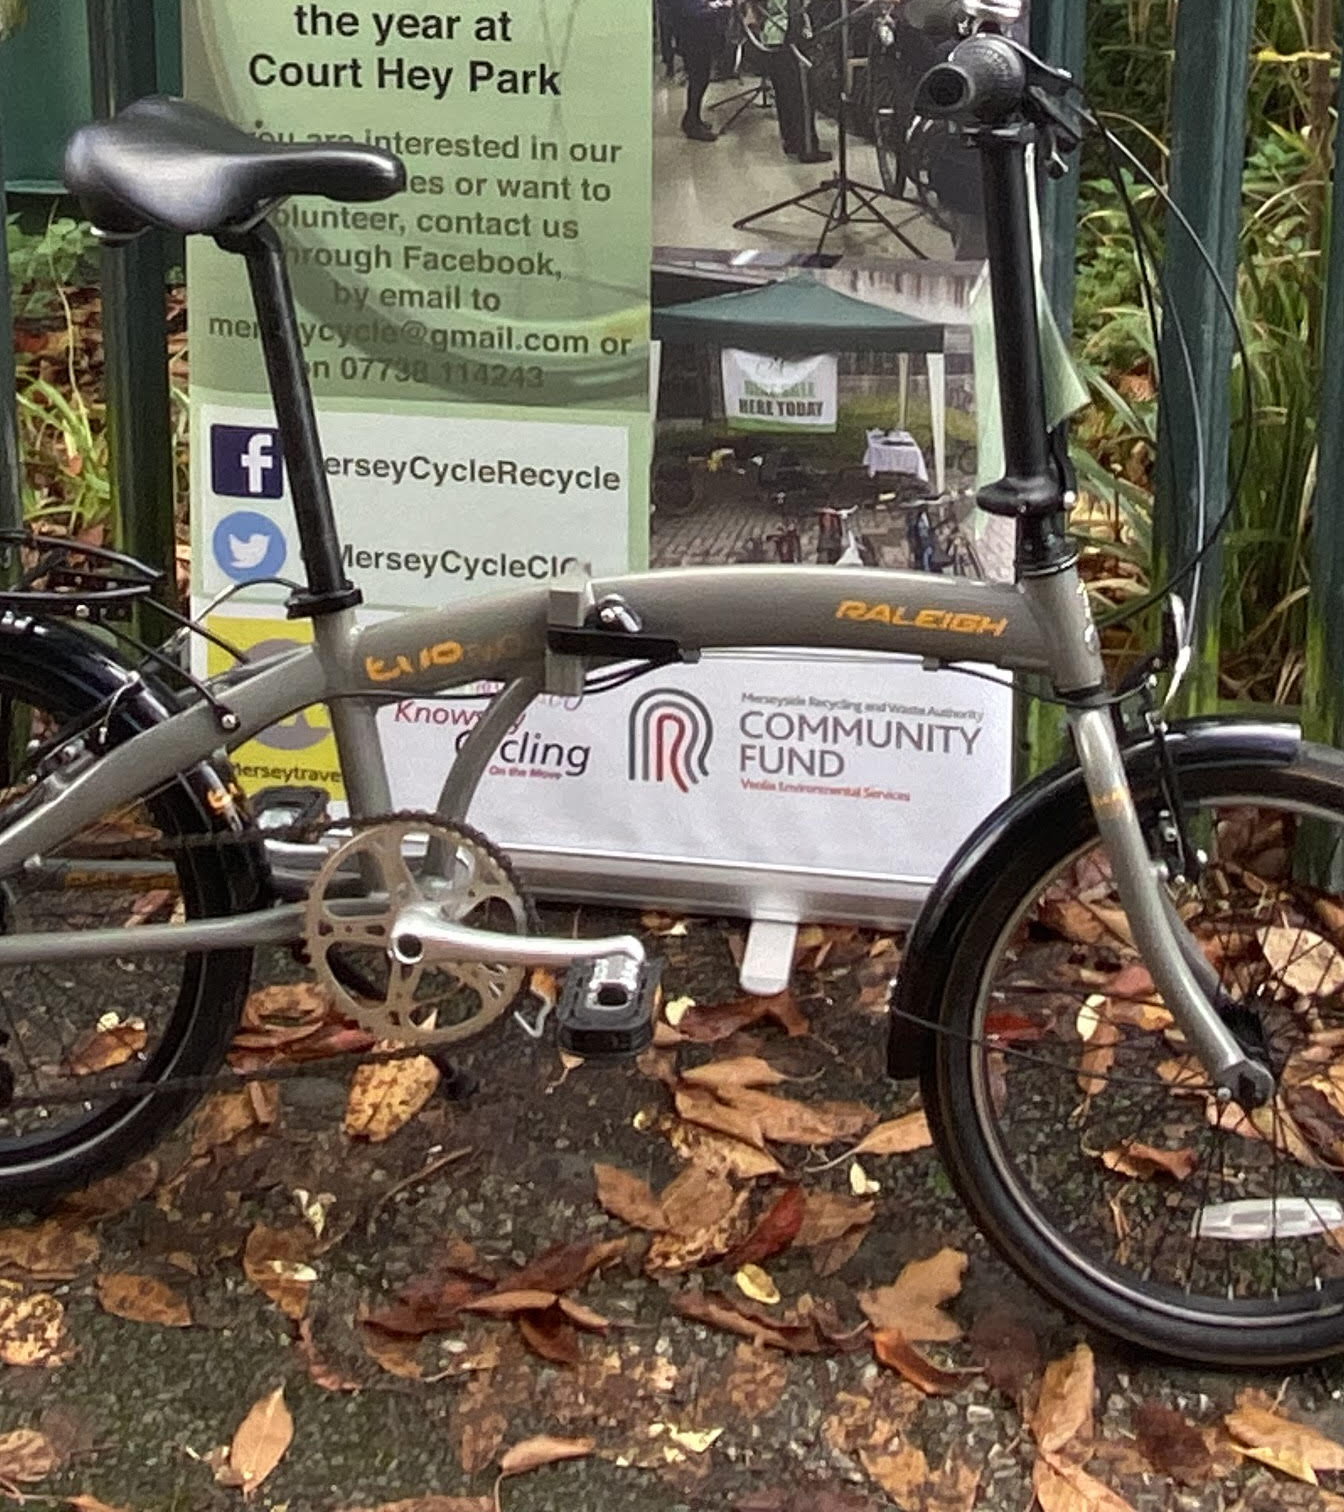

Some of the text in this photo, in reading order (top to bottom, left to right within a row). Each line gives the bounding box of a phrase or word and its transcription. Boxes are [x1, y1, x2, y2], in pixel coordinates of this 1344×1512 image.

[294, 4, 513, 47] the year at
[248, 52, 562, 101] Court Hey Park
[366, 128, 520, 161] interested
[531, 133, 557, 161] in
[568, 141, 623, 164] our
[455, 177, 488, 199] or
[496, 174, 572, 201] want
[580, 175, 612, 203] to
[272, 206, 580, 240] olunteer, contact us
[283, 241, 563, 281] hrough Facebook,
[333, 278, 501, 312] by email to
[208, 316, 633, 359] merycycle@gmail.com or
[323, 453, 622, 494] erseyCycleRecycle
[835, 599, 1009, 638] RALEIGH
[739, 710, 983, 757] COMMUNITY
[233, 763, 342, 782] erseytrave
[739, 743, 846, 778] FUND
